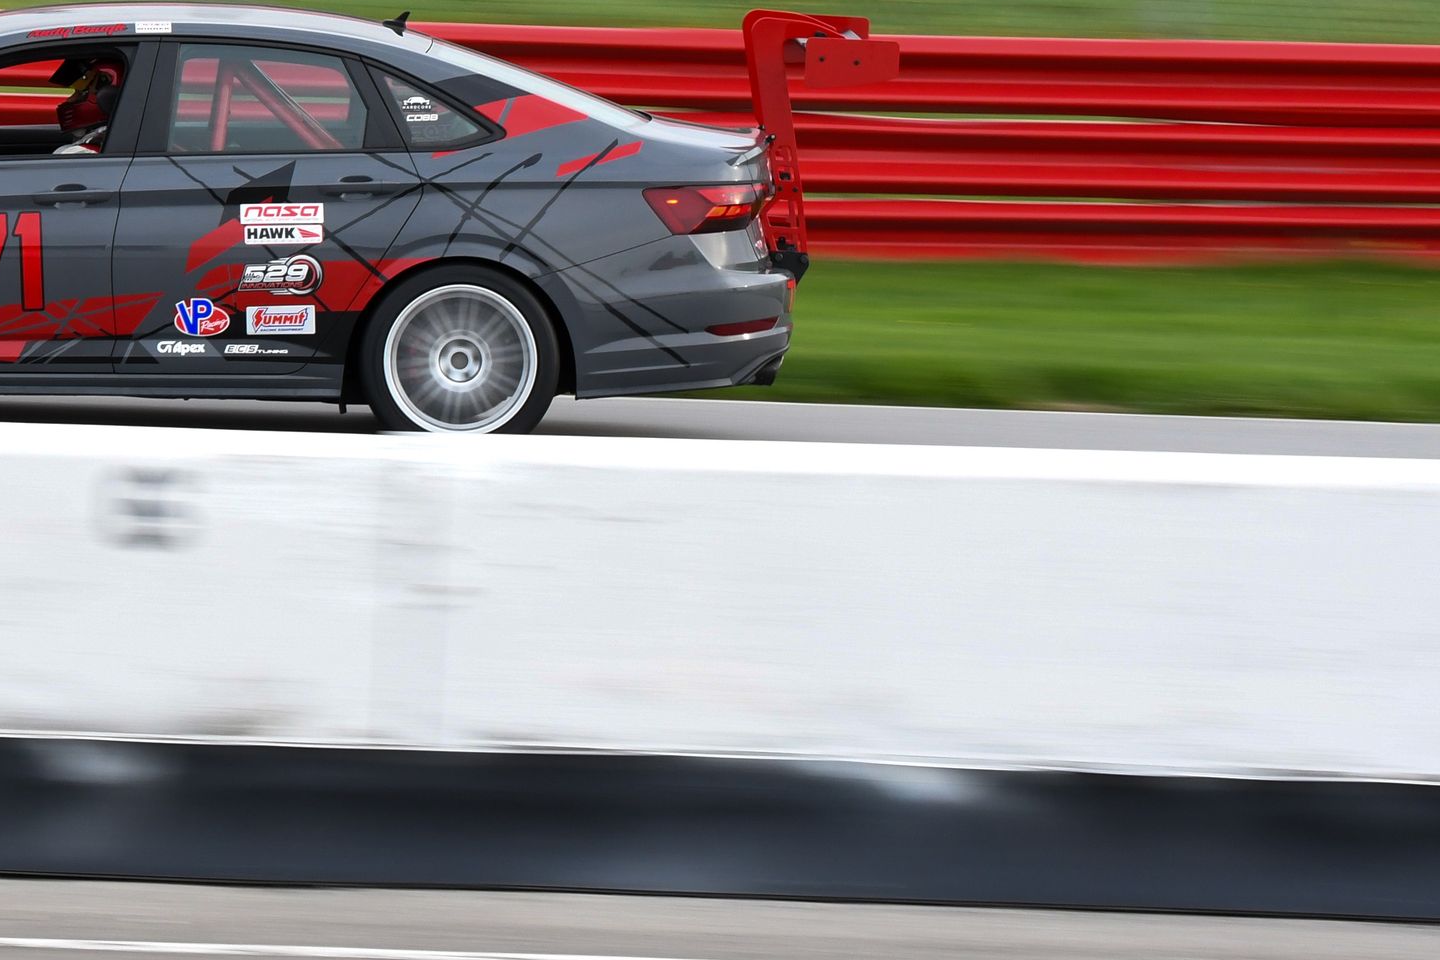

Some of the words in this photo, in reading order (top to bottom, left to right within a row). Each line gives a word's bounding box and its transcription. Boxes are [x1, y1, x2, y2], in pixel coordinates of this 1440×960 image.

[247, 227, 295, 239] HAWK
[243, 264, 308, 282] 529
[241, 281, 304, 289] INNOVATIONS
[176, 298, 214, 335] VP
[201, 319, 229, 333] Racing
[224, 344, 259, 354] ECS
